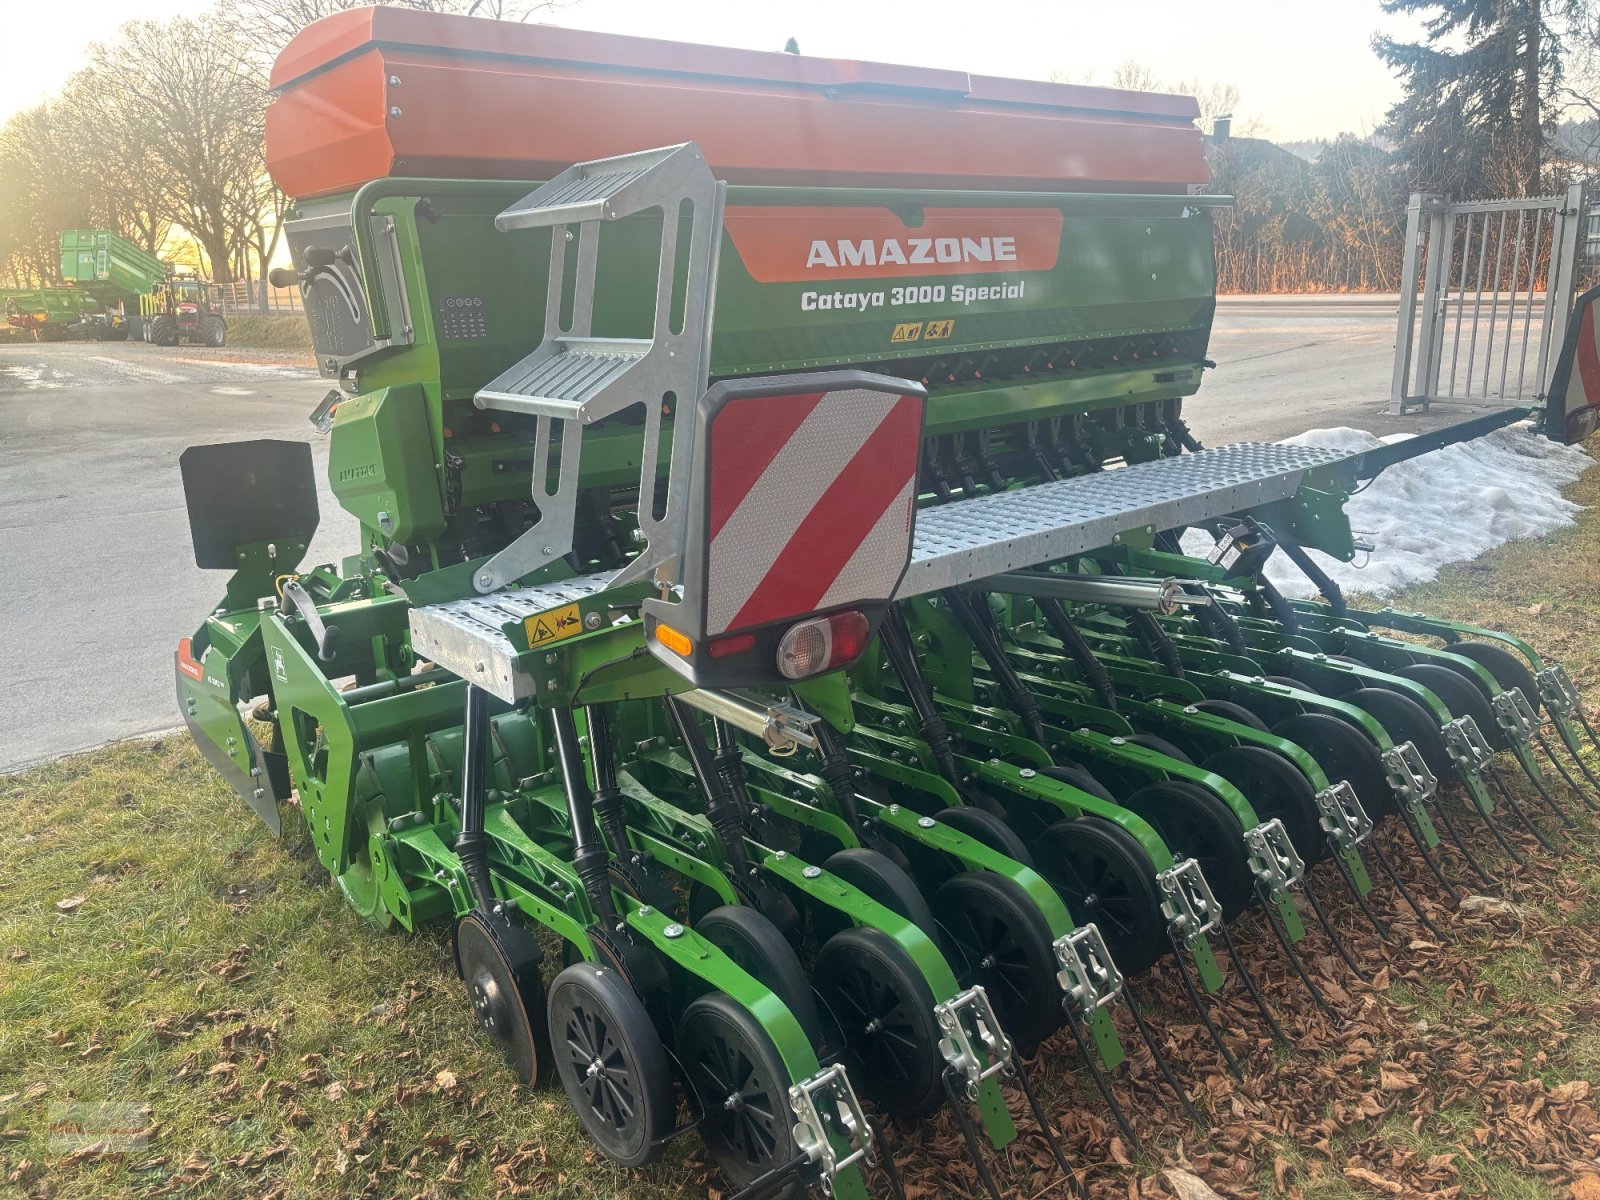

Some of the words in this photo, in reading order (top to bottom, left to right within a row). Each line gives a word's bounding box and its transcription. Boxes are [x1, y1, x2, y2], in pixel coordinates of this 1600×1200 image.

[806, 236, 1017, 268] AMAZONE
[801, 291, 885, 311] Cataya
[891, 285, 946, 305] 3000
[951, 281, 1025, 305] Special
